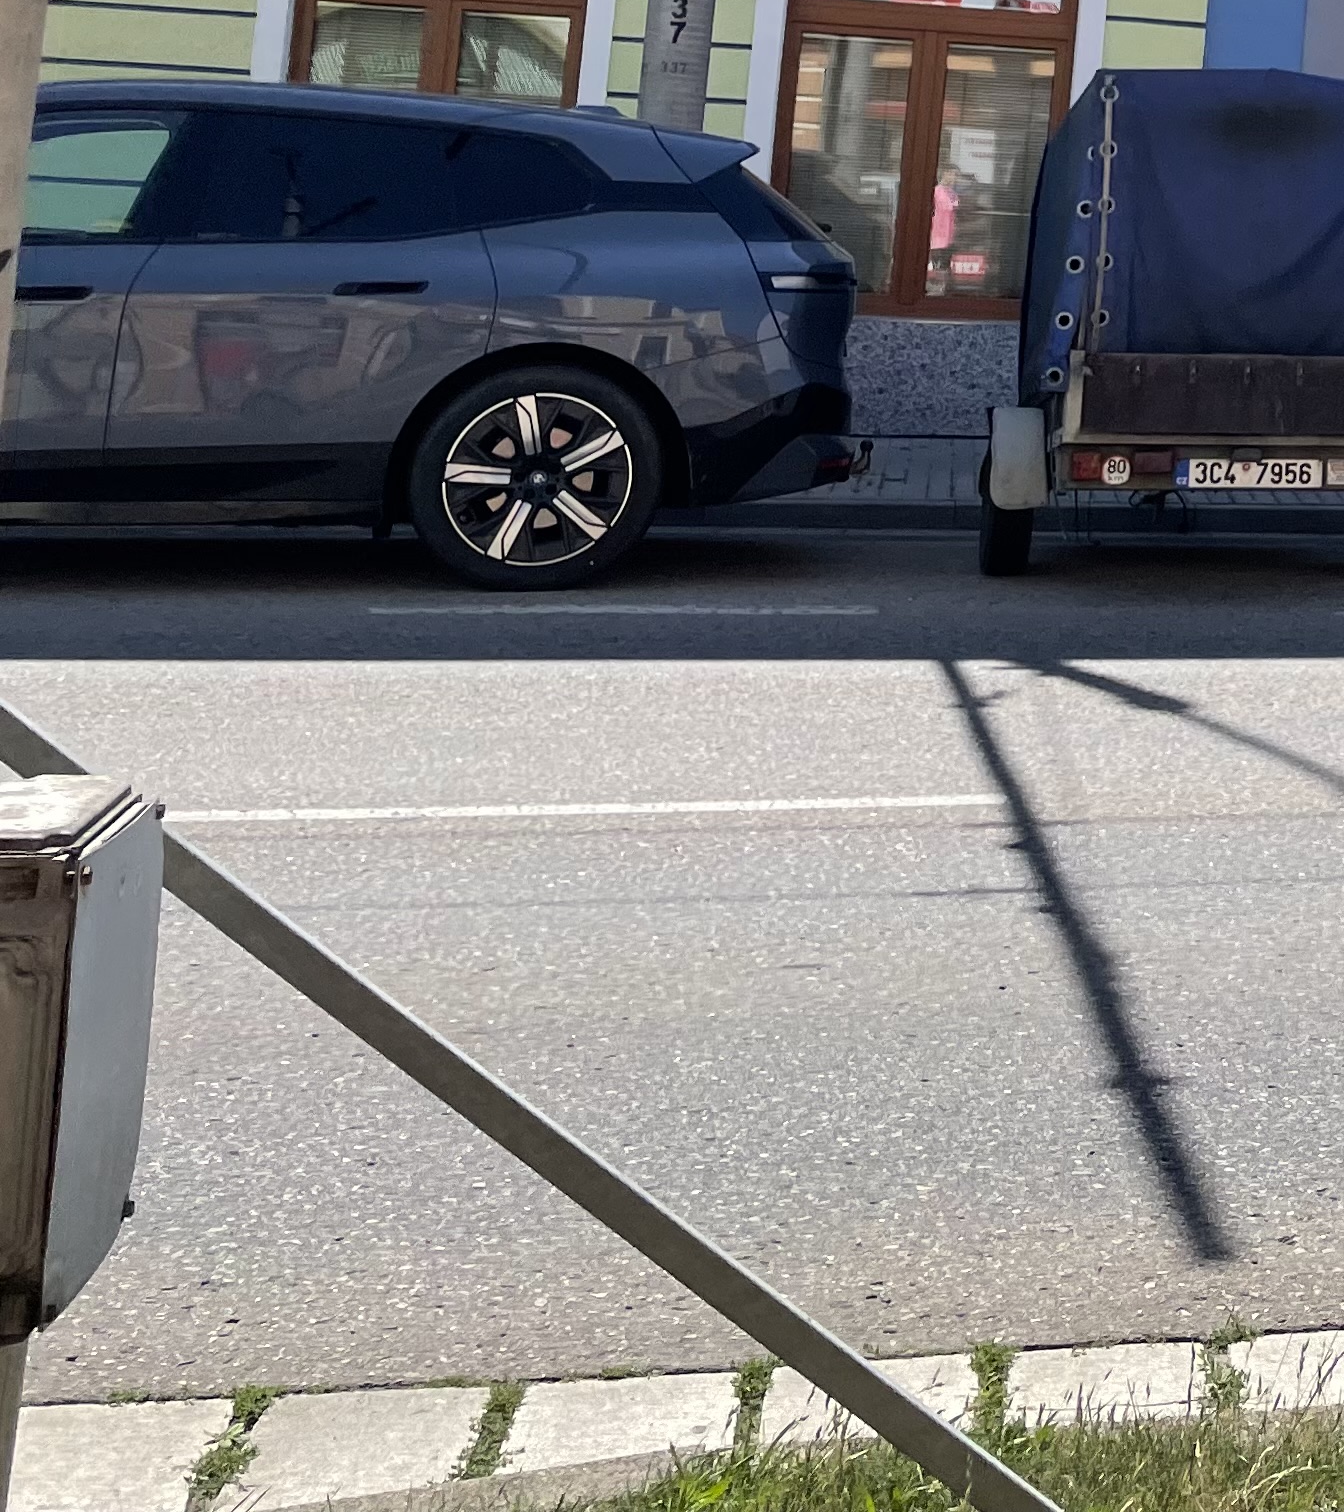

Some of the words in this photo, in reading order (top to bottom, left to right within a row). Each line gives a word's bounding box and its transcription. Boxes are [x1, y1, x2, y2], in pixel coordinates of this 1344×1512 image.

[1107, 459, 1127, 474] 80
[1194, 461, 1237, 485] 3C4
[1256, 461, 1312, 485] 7956
